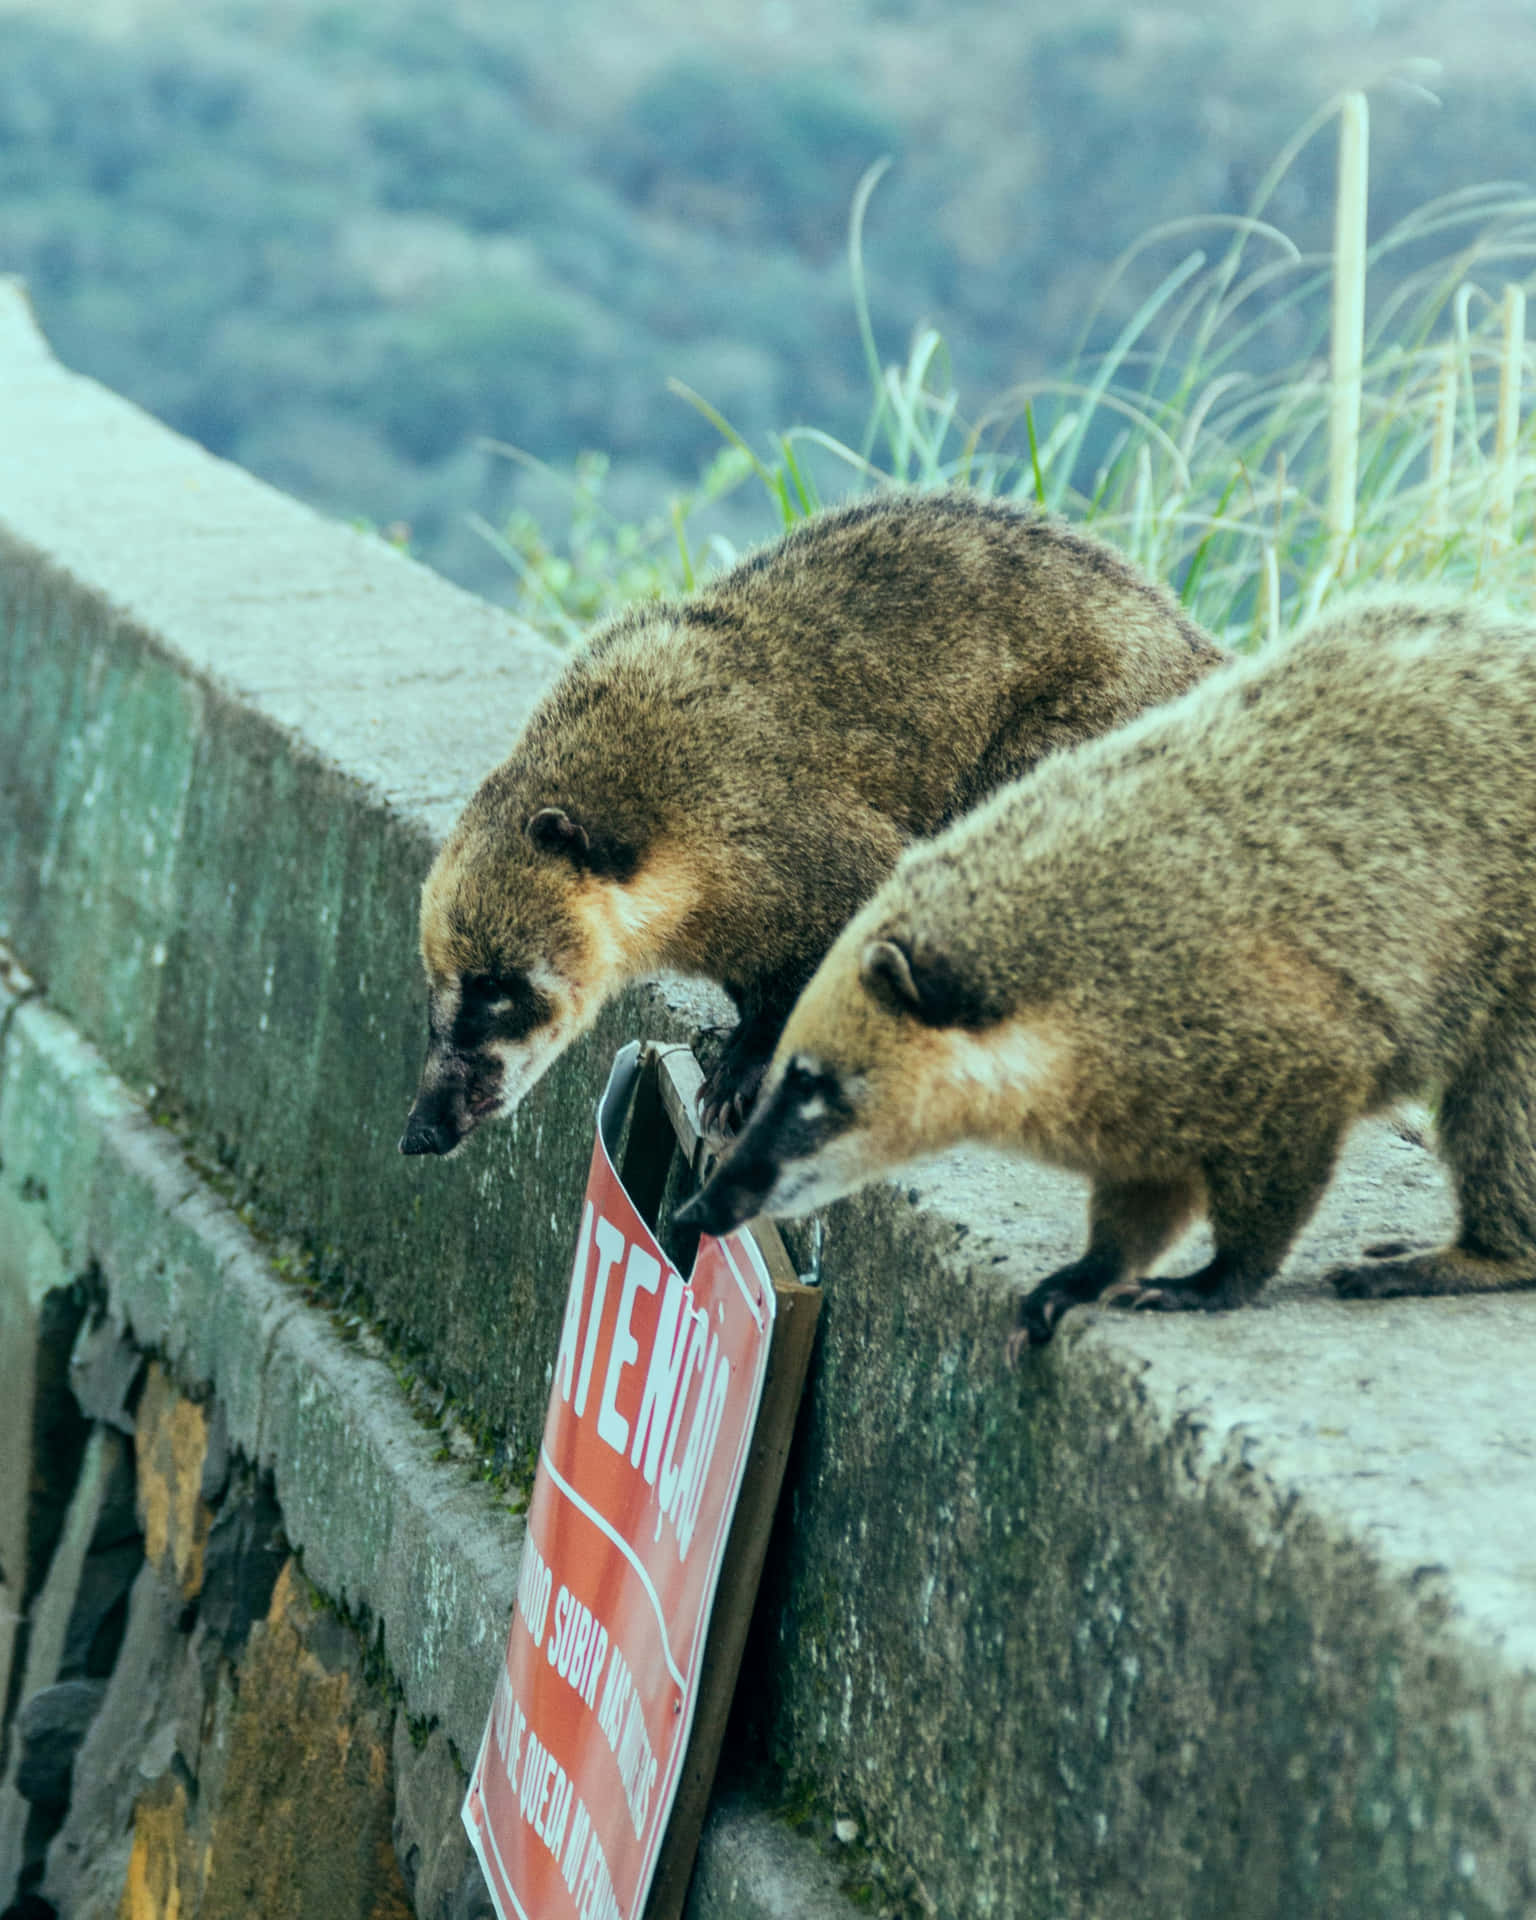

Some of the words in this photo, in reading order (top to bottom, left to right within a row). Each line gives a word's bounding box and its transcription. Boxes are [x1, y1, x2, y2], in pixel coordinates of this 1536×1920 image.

[554, 1199, 730, 1563] ATENÇÃO
[547, 1584, 609, 1711] SUBIR
[519, 1731, 574, 1863] QUEDA
